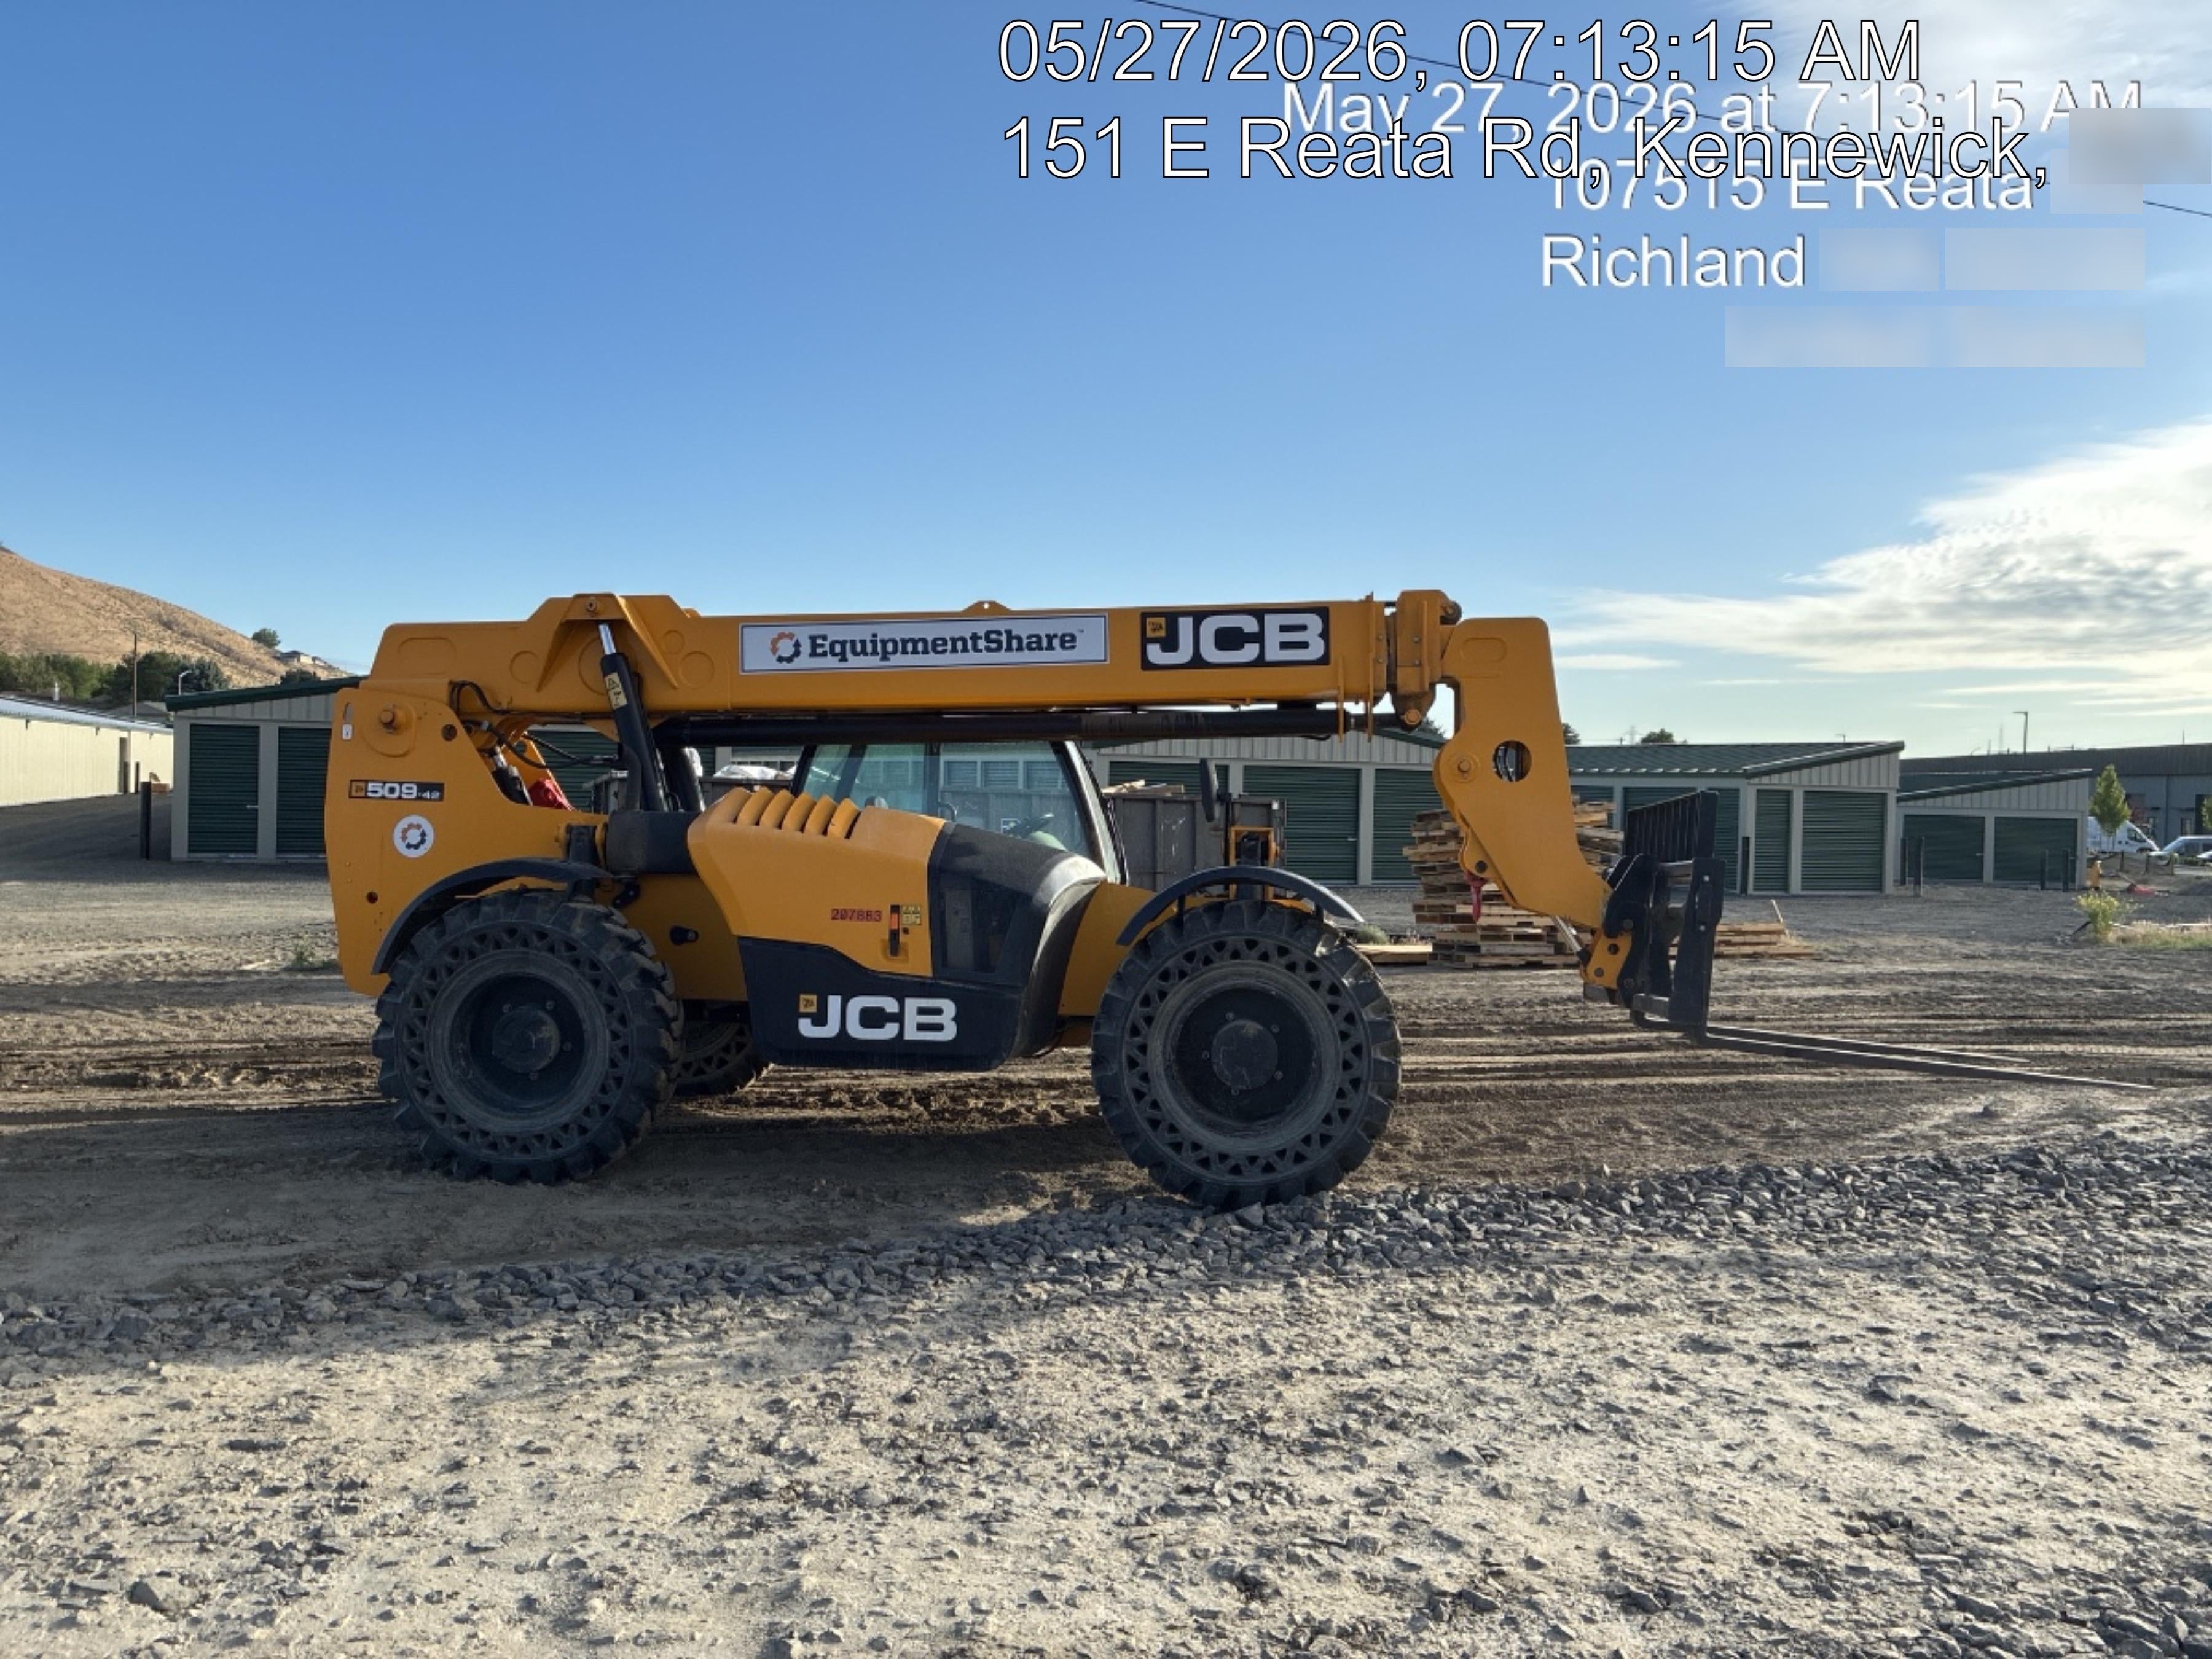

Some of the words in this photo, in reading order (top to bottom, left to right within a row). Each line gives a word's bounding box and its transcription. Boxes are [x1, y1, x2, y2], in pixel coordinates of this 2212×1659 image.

[809, 629, 1077, 662] EquipmentShare
[1146, 613, 1325, 664] JCB
[798, 995, 957, 1042] JCB
